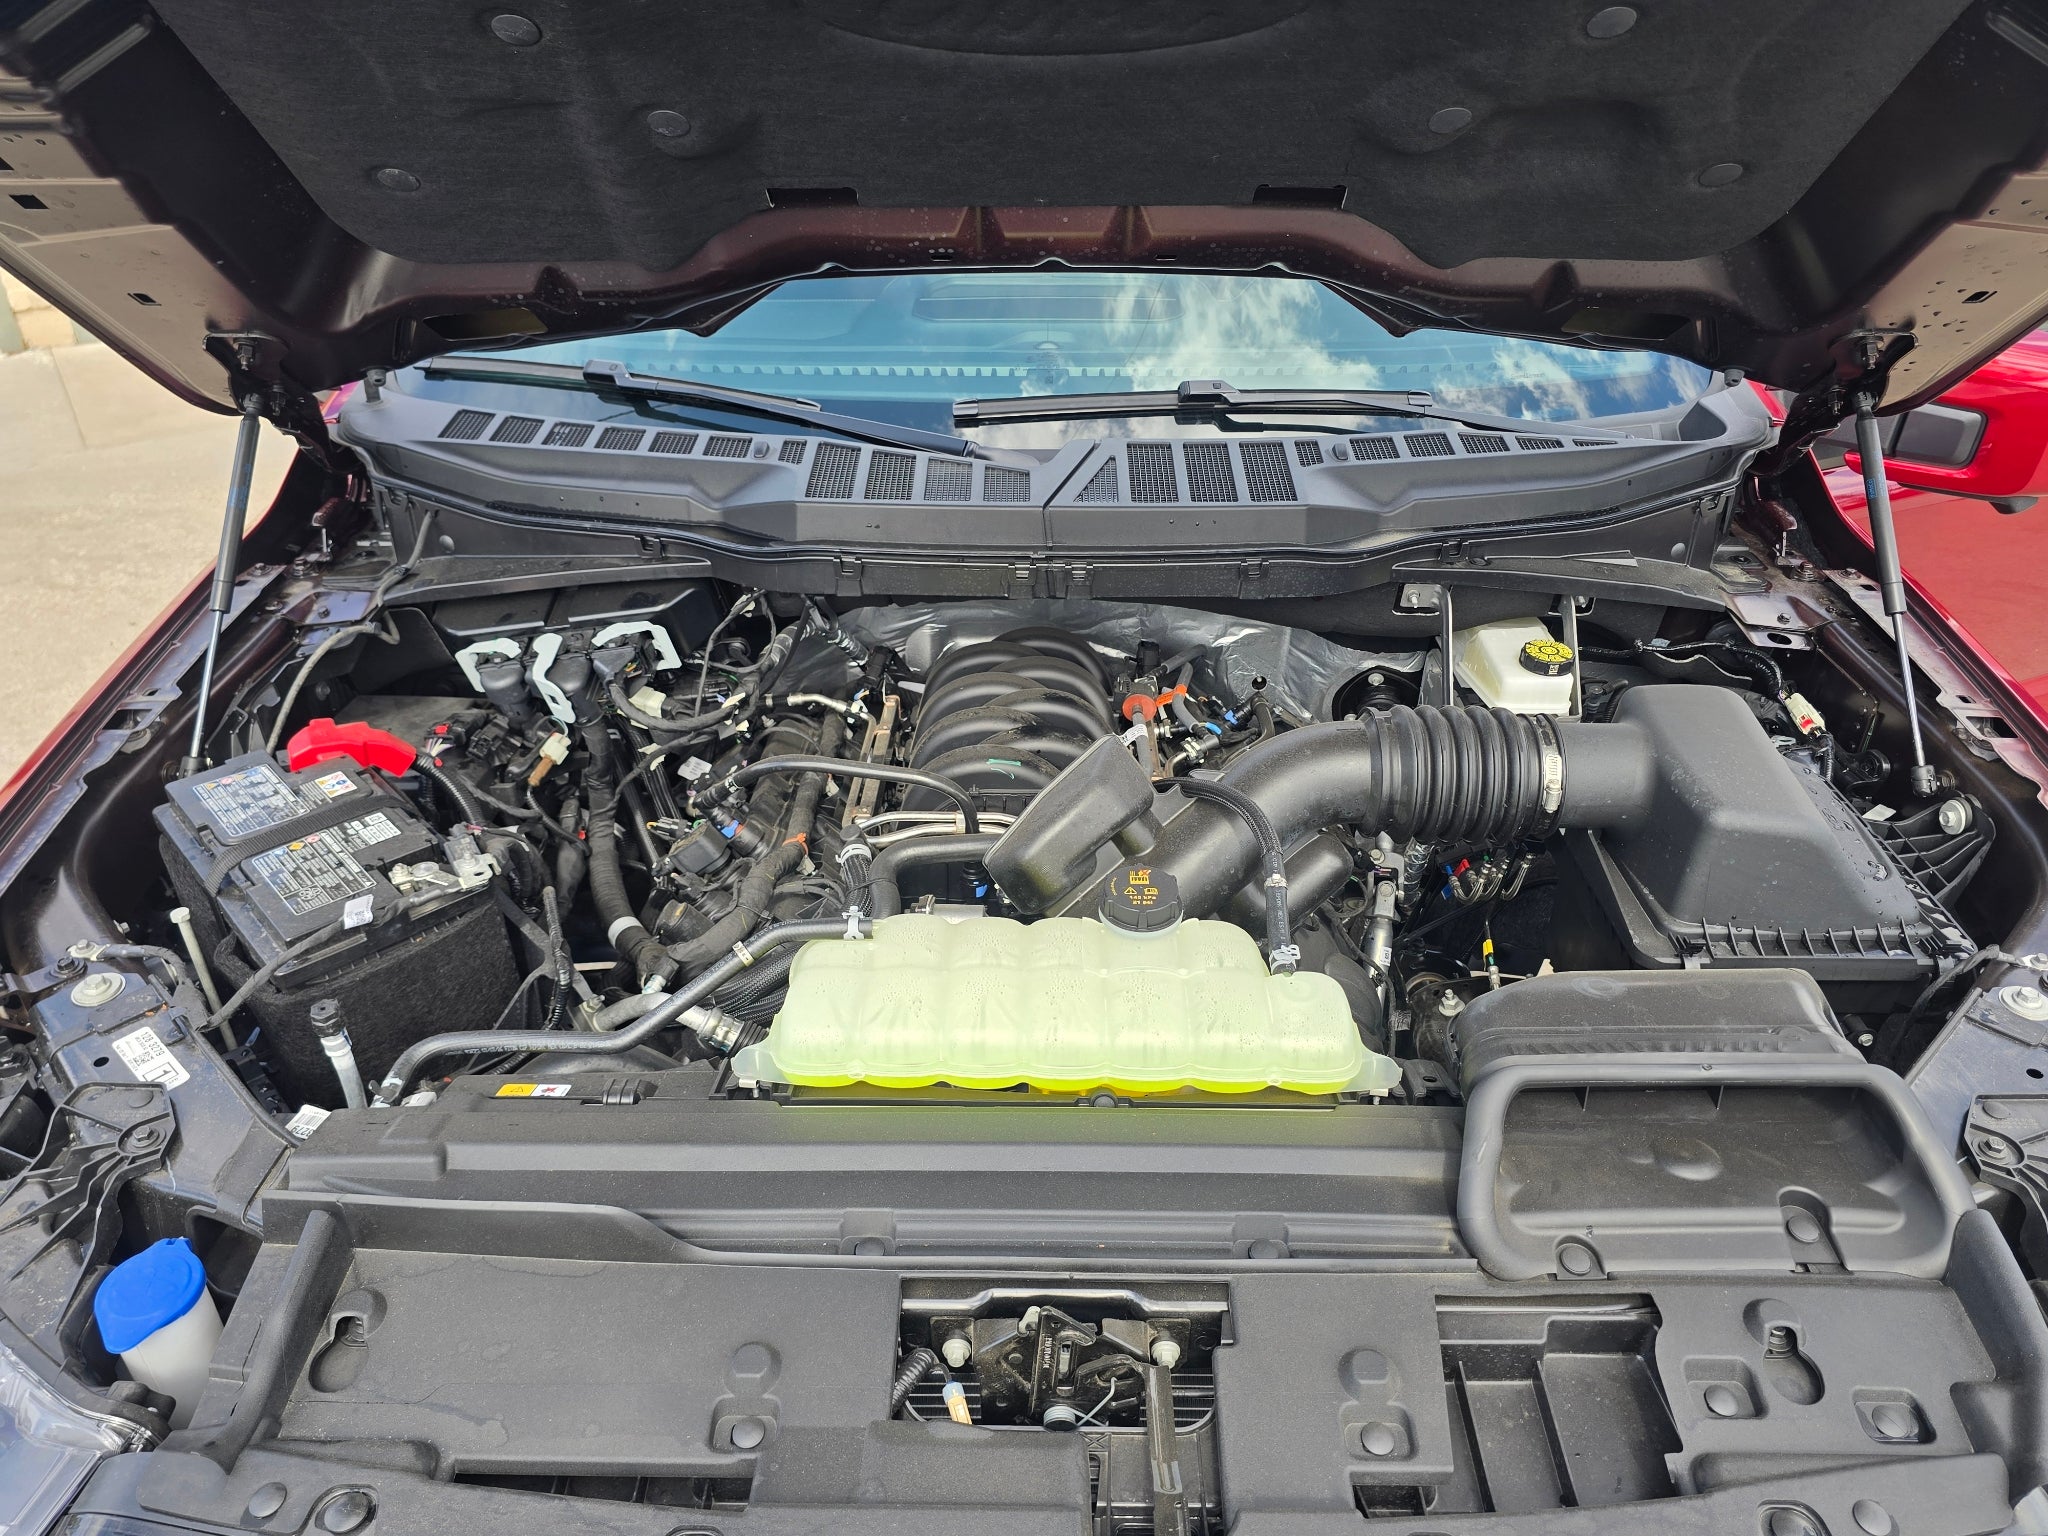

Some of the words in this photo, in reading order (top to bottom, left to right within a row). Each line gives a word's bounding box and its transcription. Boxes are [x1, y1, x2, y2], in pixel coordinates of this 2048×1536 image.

[140, 1031, 154, 1043] 128
[148, 1041, 166, 1057] 3279
[291, 1125, 314, 1138] 3279
